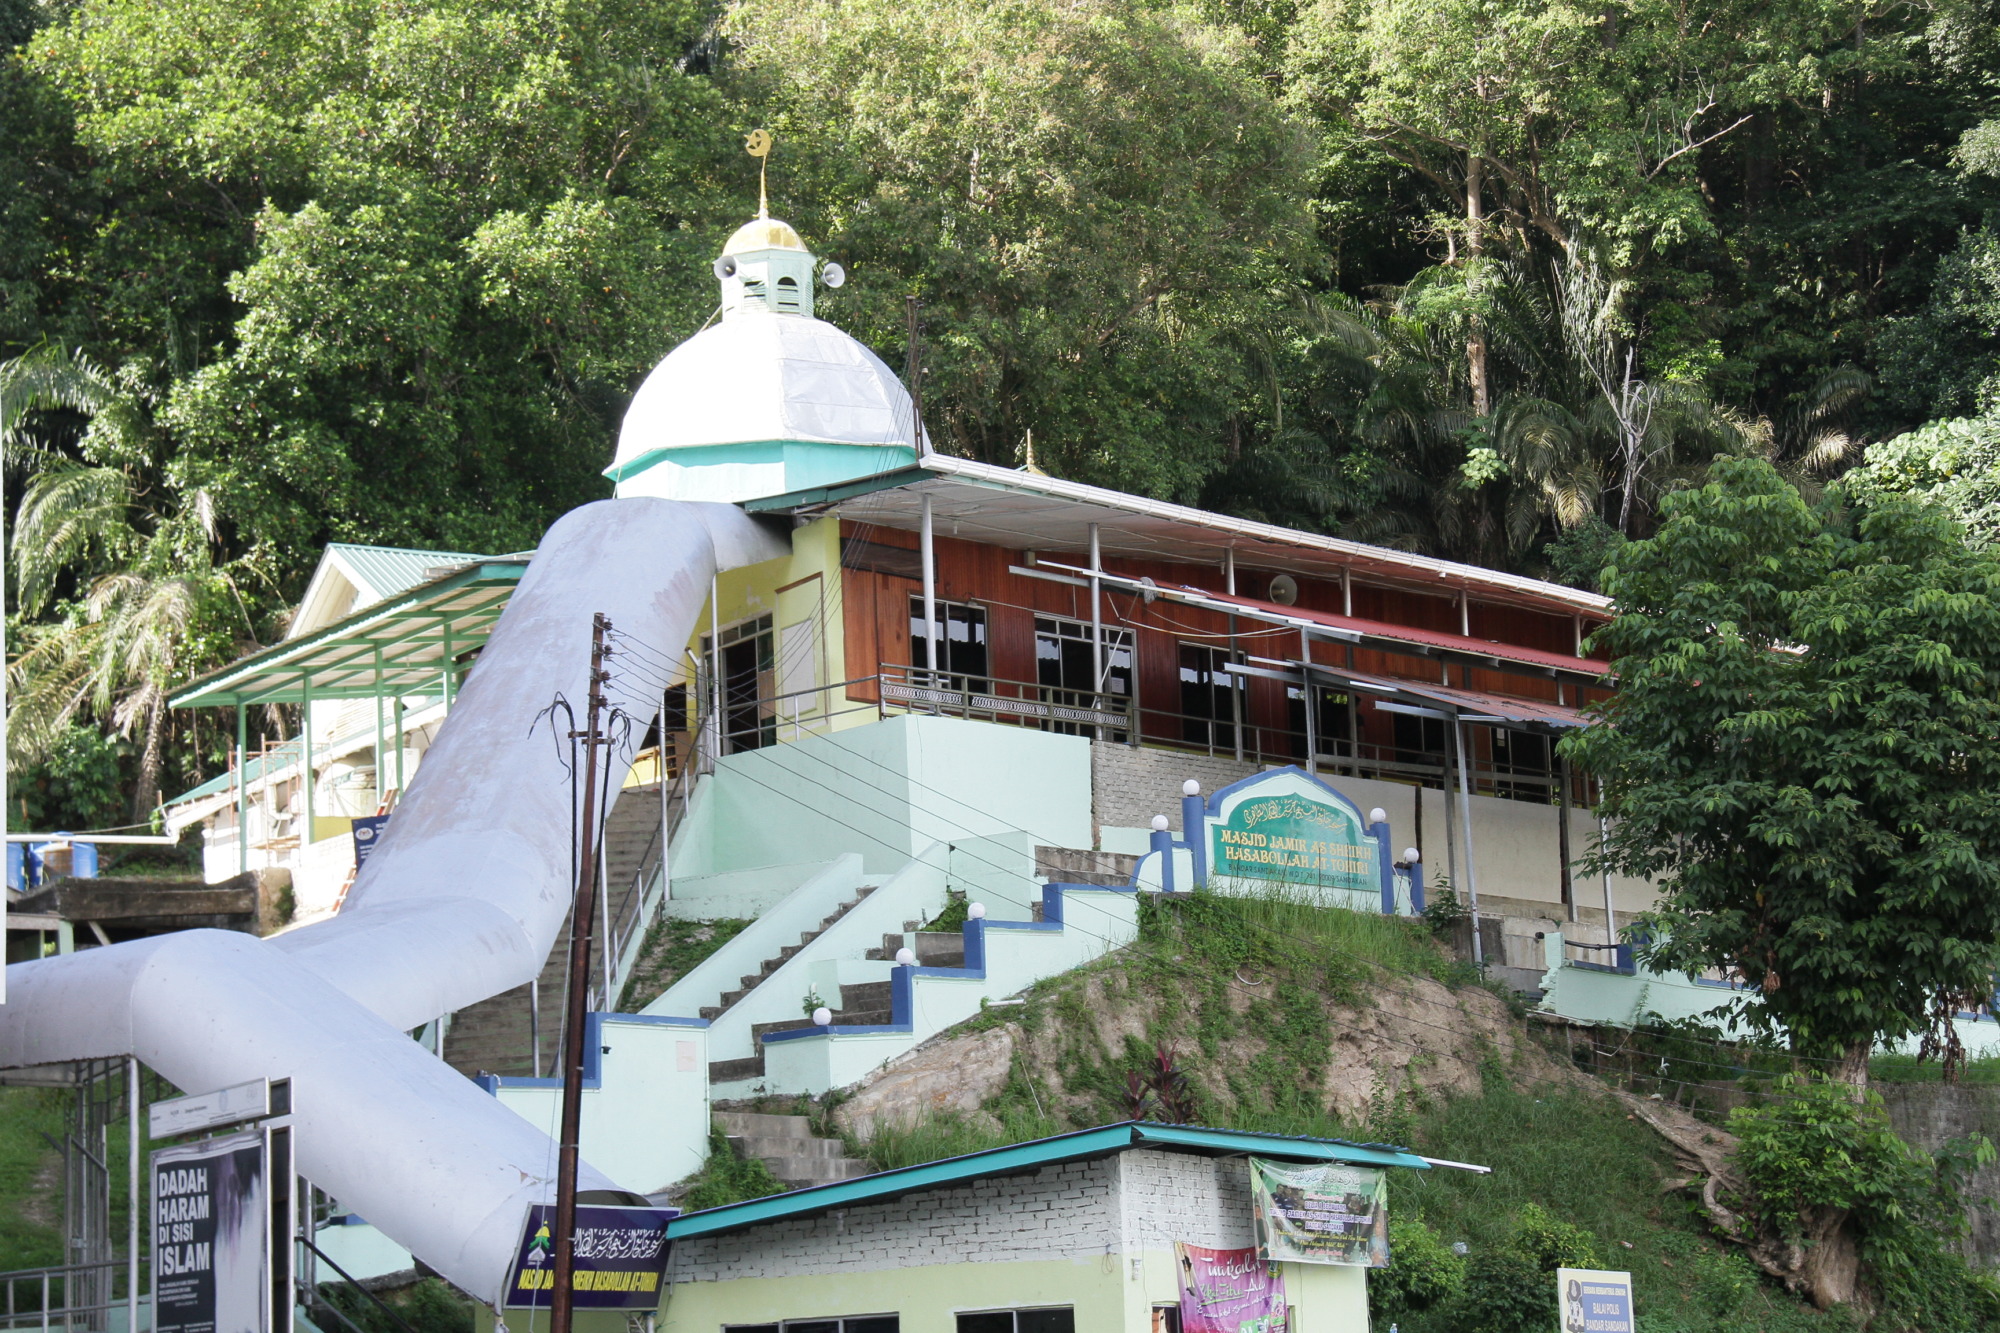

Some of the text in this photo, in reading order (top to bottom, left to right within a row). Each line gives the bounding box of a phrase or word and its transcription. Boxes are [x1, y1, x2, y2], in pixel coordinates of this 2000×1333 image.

[1221, 829, 1267, 847] MASJID
[1310, 841, 1327, 855] AS
[1329, 842, 1372, 860] SHEIKH
[1226, 846, 1309, 868] HASABOLLAH
[159, 1167, 208, 1197] DADAH
[159, 1195, 209, 1224] HARAM
[159, 1222, 194, 1244] DI SISI
[159, 1242, 210, 1276] ISLAM
[1607, 1303, 1620, 1315] POLIS
[1586, 1319, 1629, 1332] BANDAR SANDAKAN
